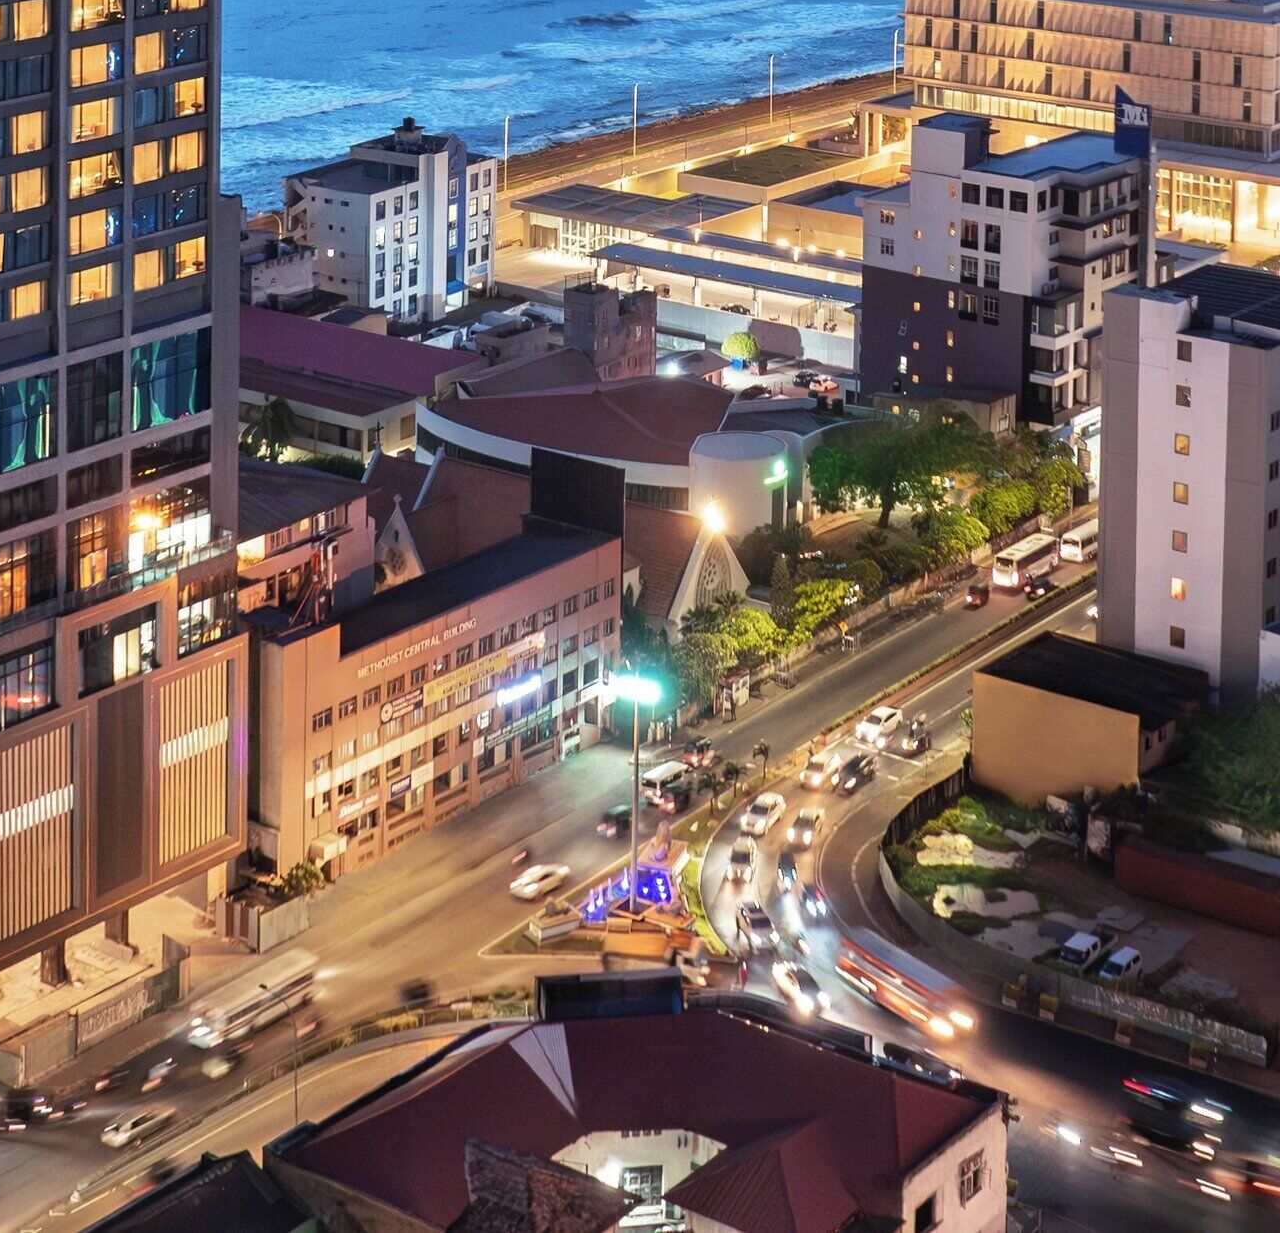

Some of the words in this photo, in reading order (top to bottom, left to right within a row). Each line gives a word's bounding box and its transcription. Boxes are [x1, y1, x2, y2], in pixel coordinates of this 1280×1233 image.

[357, 650, 403, 679] METHODIST
[404, 634, 441, 659] CENTRAL
[443, 617, 477, 641] BUILDING
